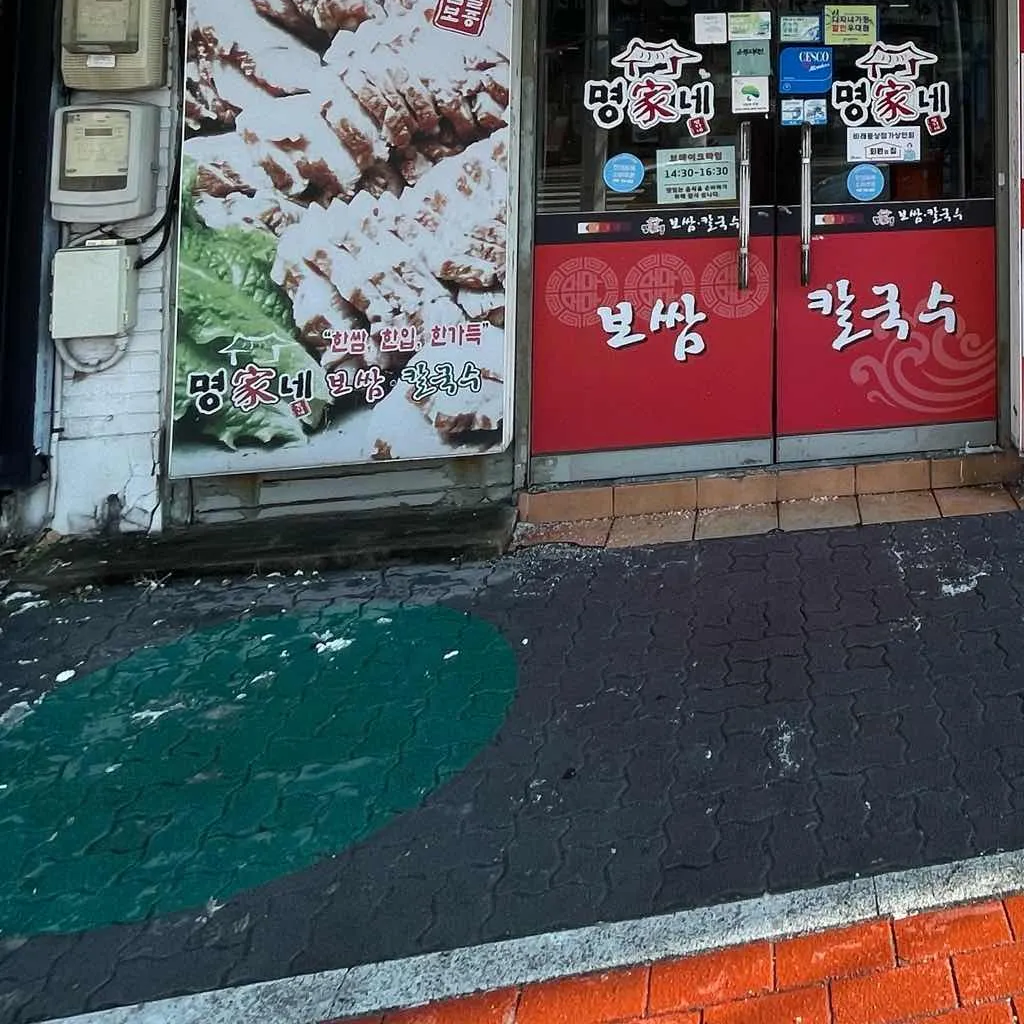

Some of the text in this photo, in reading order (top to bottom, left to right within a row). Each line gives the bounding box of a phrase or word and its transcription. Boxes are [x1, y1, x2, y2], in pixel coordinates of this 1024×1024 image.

[799, 51, 830, 62] CESCO
[584, 73, 715, 130] 명家네
[831, 73, 950, 127] 명家네
[597, 292, 707, 362] 보쌈
[807, 278, 958, 352] 칼국수
[187, 363, 313, 414] 명家네
